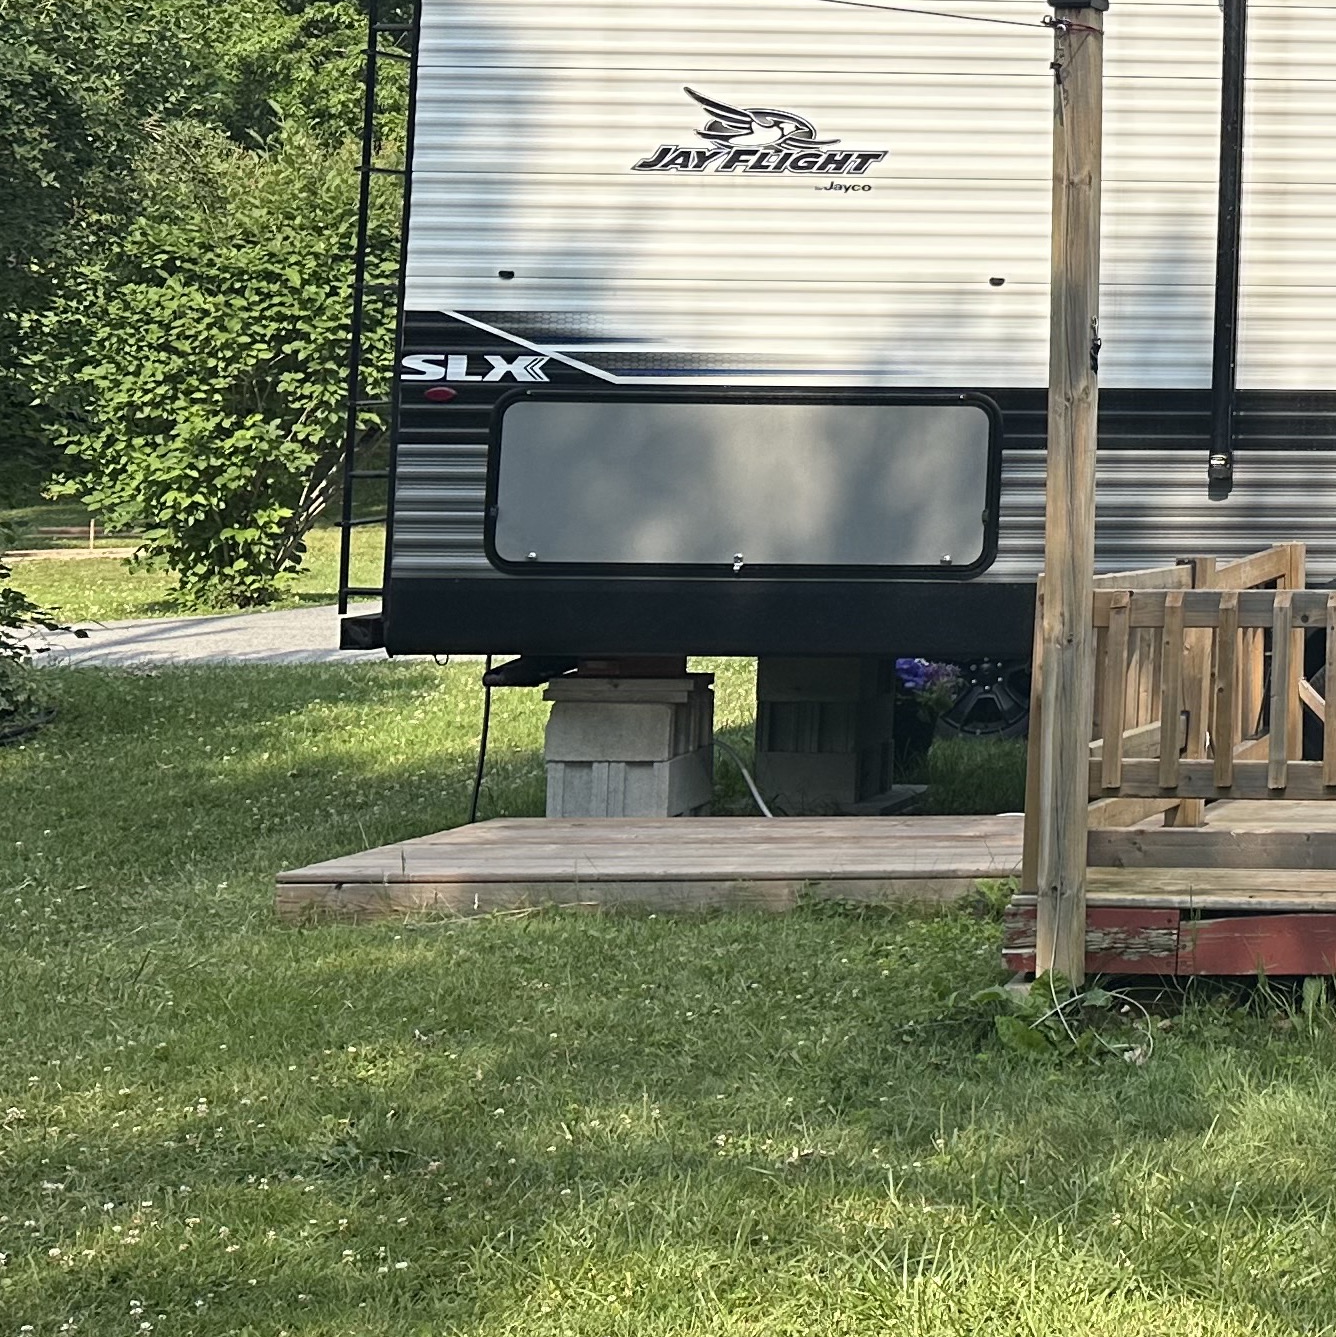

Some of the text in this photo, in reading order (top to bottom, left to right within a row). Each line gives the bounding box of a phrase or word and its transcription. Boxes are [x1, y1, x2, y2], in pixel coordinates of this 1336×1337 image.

[632, 144, 888, 174] JAY FLIGHT
[824, 181, 872, 193] Jayco
[401, 354, 550, 382] SLX
